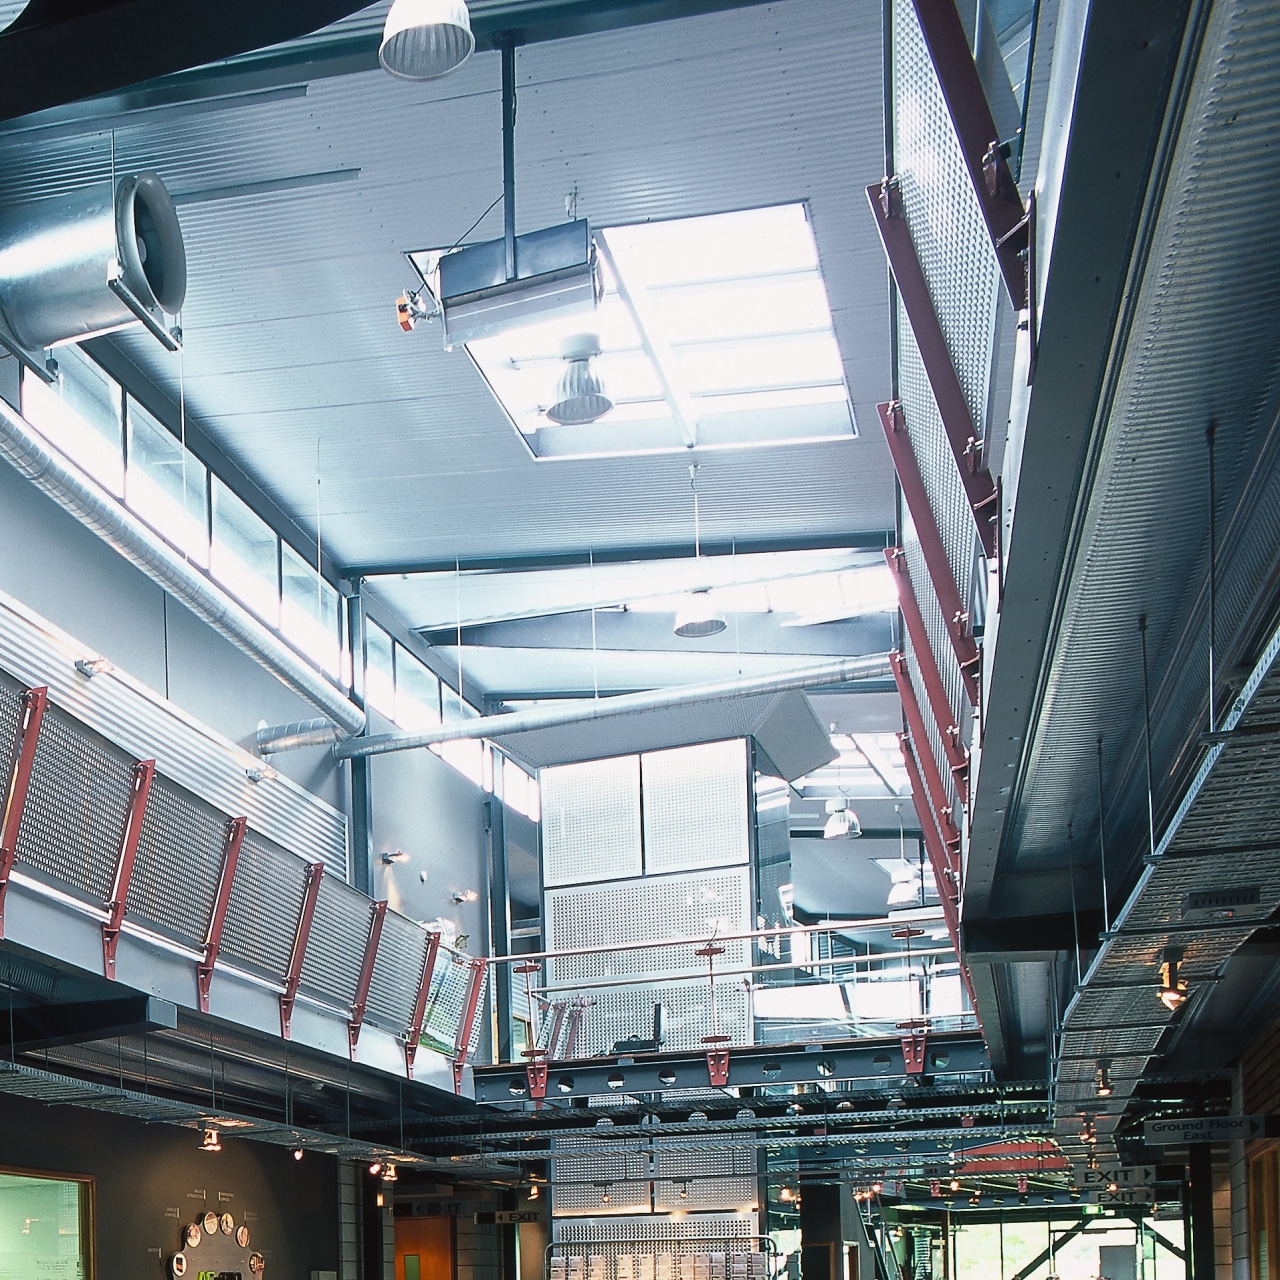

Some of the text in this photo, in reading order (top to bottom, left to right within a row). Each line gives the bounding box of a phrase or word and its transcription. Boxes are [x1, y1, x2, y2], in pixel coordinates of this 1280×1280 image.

[1152, 1118, 1245, 1132] Ground Floor
[1183, 1131, 1212, 1140] East
[1084, 1169, 1133, 1183] EXIT
[1097, 1191, 1137, 1203] EXIT
[427, 1203, 461, 1214] EXIT
[508, 1212, 540, 1222] EXIT
